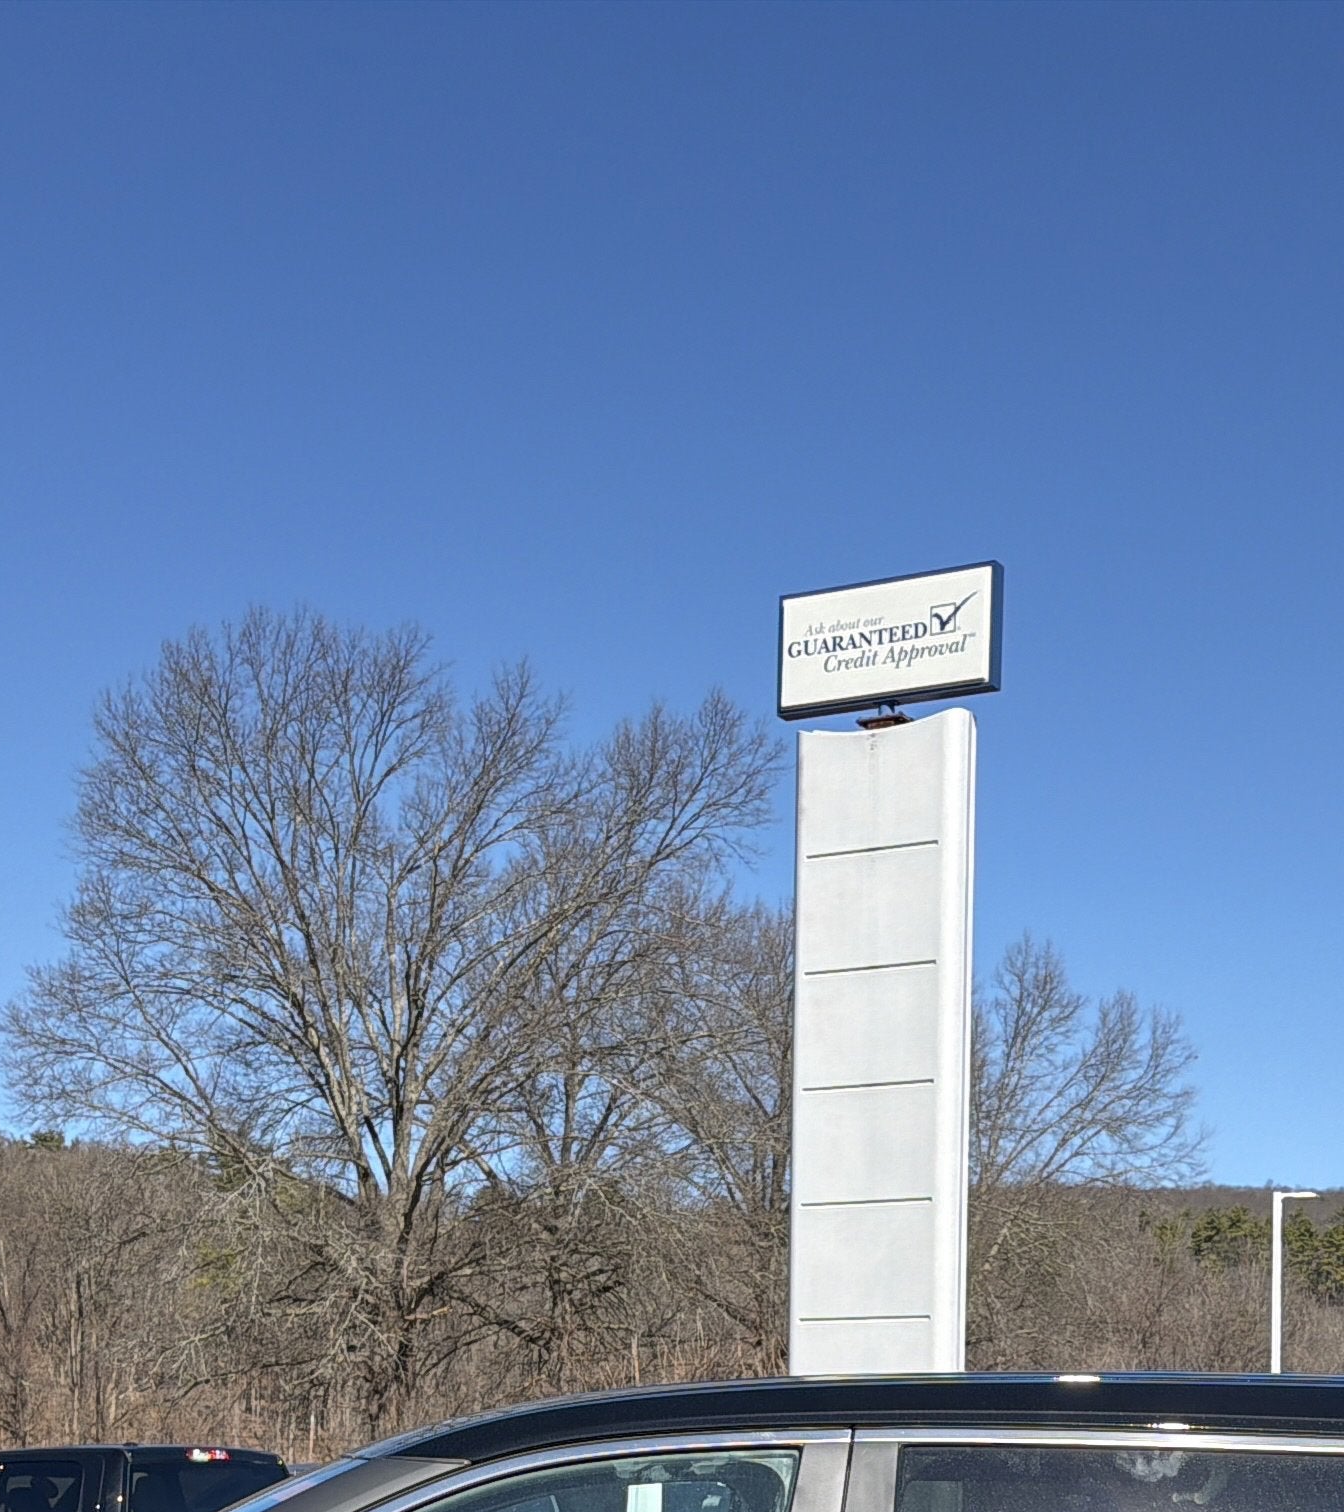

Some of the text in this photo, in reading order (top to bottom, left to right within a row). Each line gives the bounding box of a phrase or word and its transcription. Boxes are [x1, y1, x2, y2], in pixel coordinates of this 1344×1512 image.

[805, 616, 884, 636] Ask about our
[788, 622, 927, 659] GUARANTEED
[823, 645, 879, 673] Credit
